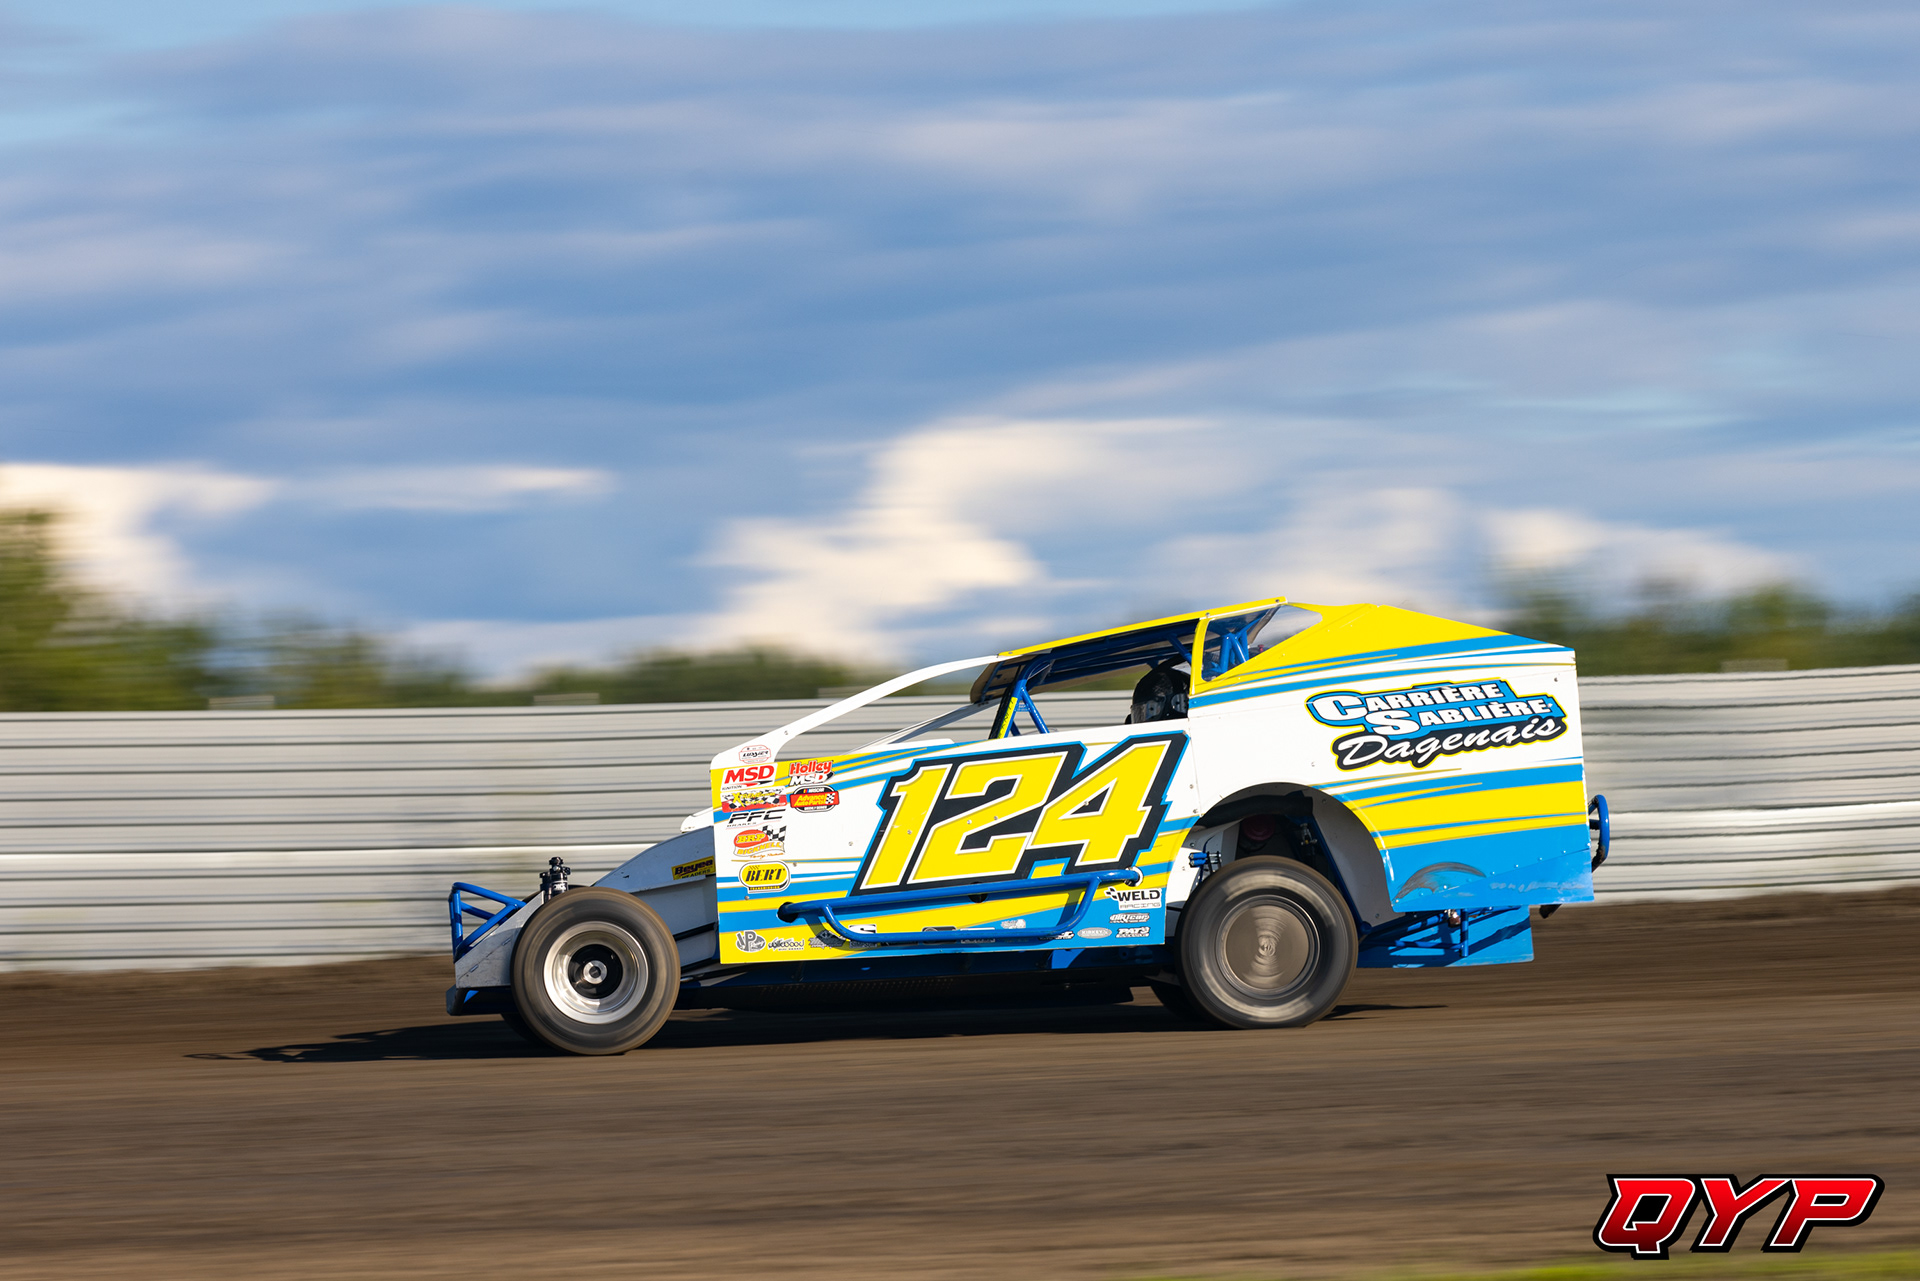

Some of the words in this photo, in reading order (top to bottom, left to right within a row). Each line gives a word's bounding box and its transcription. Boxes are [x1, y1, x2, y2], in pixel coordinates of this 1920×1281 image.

[1313, 683, 1504, 721] CARRIÈRE
[1365, 699, 1552, 736] SABLIÈRE
[1337, 717, 1562, 766] Dagenais
[724, 765, 775, 785] MSD
[789, 760, 833, 776] Holley
[789, 773, 830, 787] MSD
[729, 809, 786, 824] PFC
[860, 740, 1173, 890] 124
[736, 833, 766, 843] BRP
[737, 841, 782, 855] BICKNELL
[745, 868, 785, 881] BERT
[1117, 890, 1160, 901] WELD
